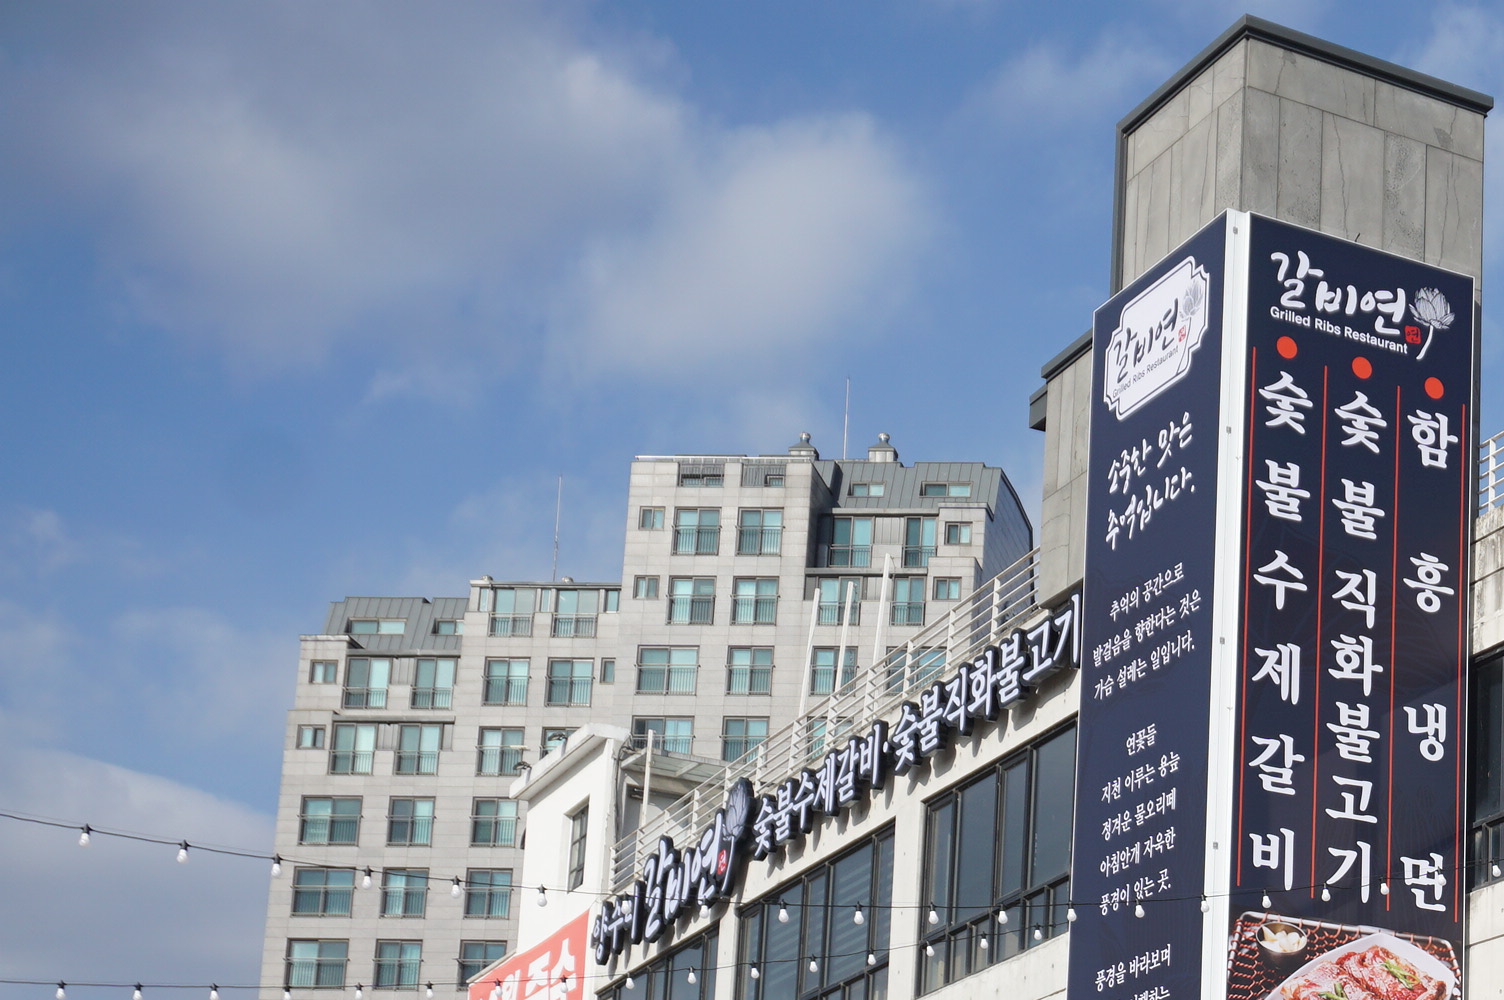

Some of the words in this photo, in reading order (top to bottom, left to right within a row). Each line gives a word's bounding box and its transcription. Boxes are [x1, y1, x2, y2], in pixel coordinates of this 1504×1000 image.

[1270, 250, 1407, 335] 갈비연
[1113, 297, 1179, 384] 갈비연
[1269, 305, 1312, 328] Grilled
[1314, 318, 1342, 336] Ribs
[1344, 326, 1408, 355] Restaurant
[1112, 377, 1132, 399] Grilled
[1132, 368, 1146, 385] Ribs
[1146, 345, 1179, 373] Restaurant
[1108, 438, 1152, 494] 소중한
[1157, 411, 1193, 468] 맛은
[1106, 466, 1195, 550] 추억입니다.
[1109, 587, 1139, 622] 추억의
[1142, 562, 1185, 602] 공간으로
[1092, 628, 1132, 667] 발걸음을
[1134, 605, 1176, 643] 향한다는
[1179, 589, 1202, 619] 것은
[1249, 370, 1313, 891] 숯불수제갈비
[1325, 391, 1387, 904] 숯불직화불고기
[1400, 409, 1458, 912] 함흥냉면
[1094, 675, 1114, 700] 가슴
[1116, 658, 1147, 689] 설레는
[1150, 630, 1195, 670] 일입니다.
[1126, 723, 1157, 756] 연꽃들
[1101, 777, 1121, 804] 지천
[1124, 764, 1156, 792] 이루는
[1101, 810, 1132, 840] 정겨운
[1134, 787, 1177, 826] 물오리떼
[643, 812, 722, 938] 갈비연
[1100, 842, 1140, 877] 아침안개
[1143, 827, 1176, 858] 자욱한
[1099, 883, 1130, 916] 풍경이
[1133, 876, 1155, 900] 있는
[1094, 961, 1126, 992] 풍경을
[1129, 943, 1171, 978] 바라보며
